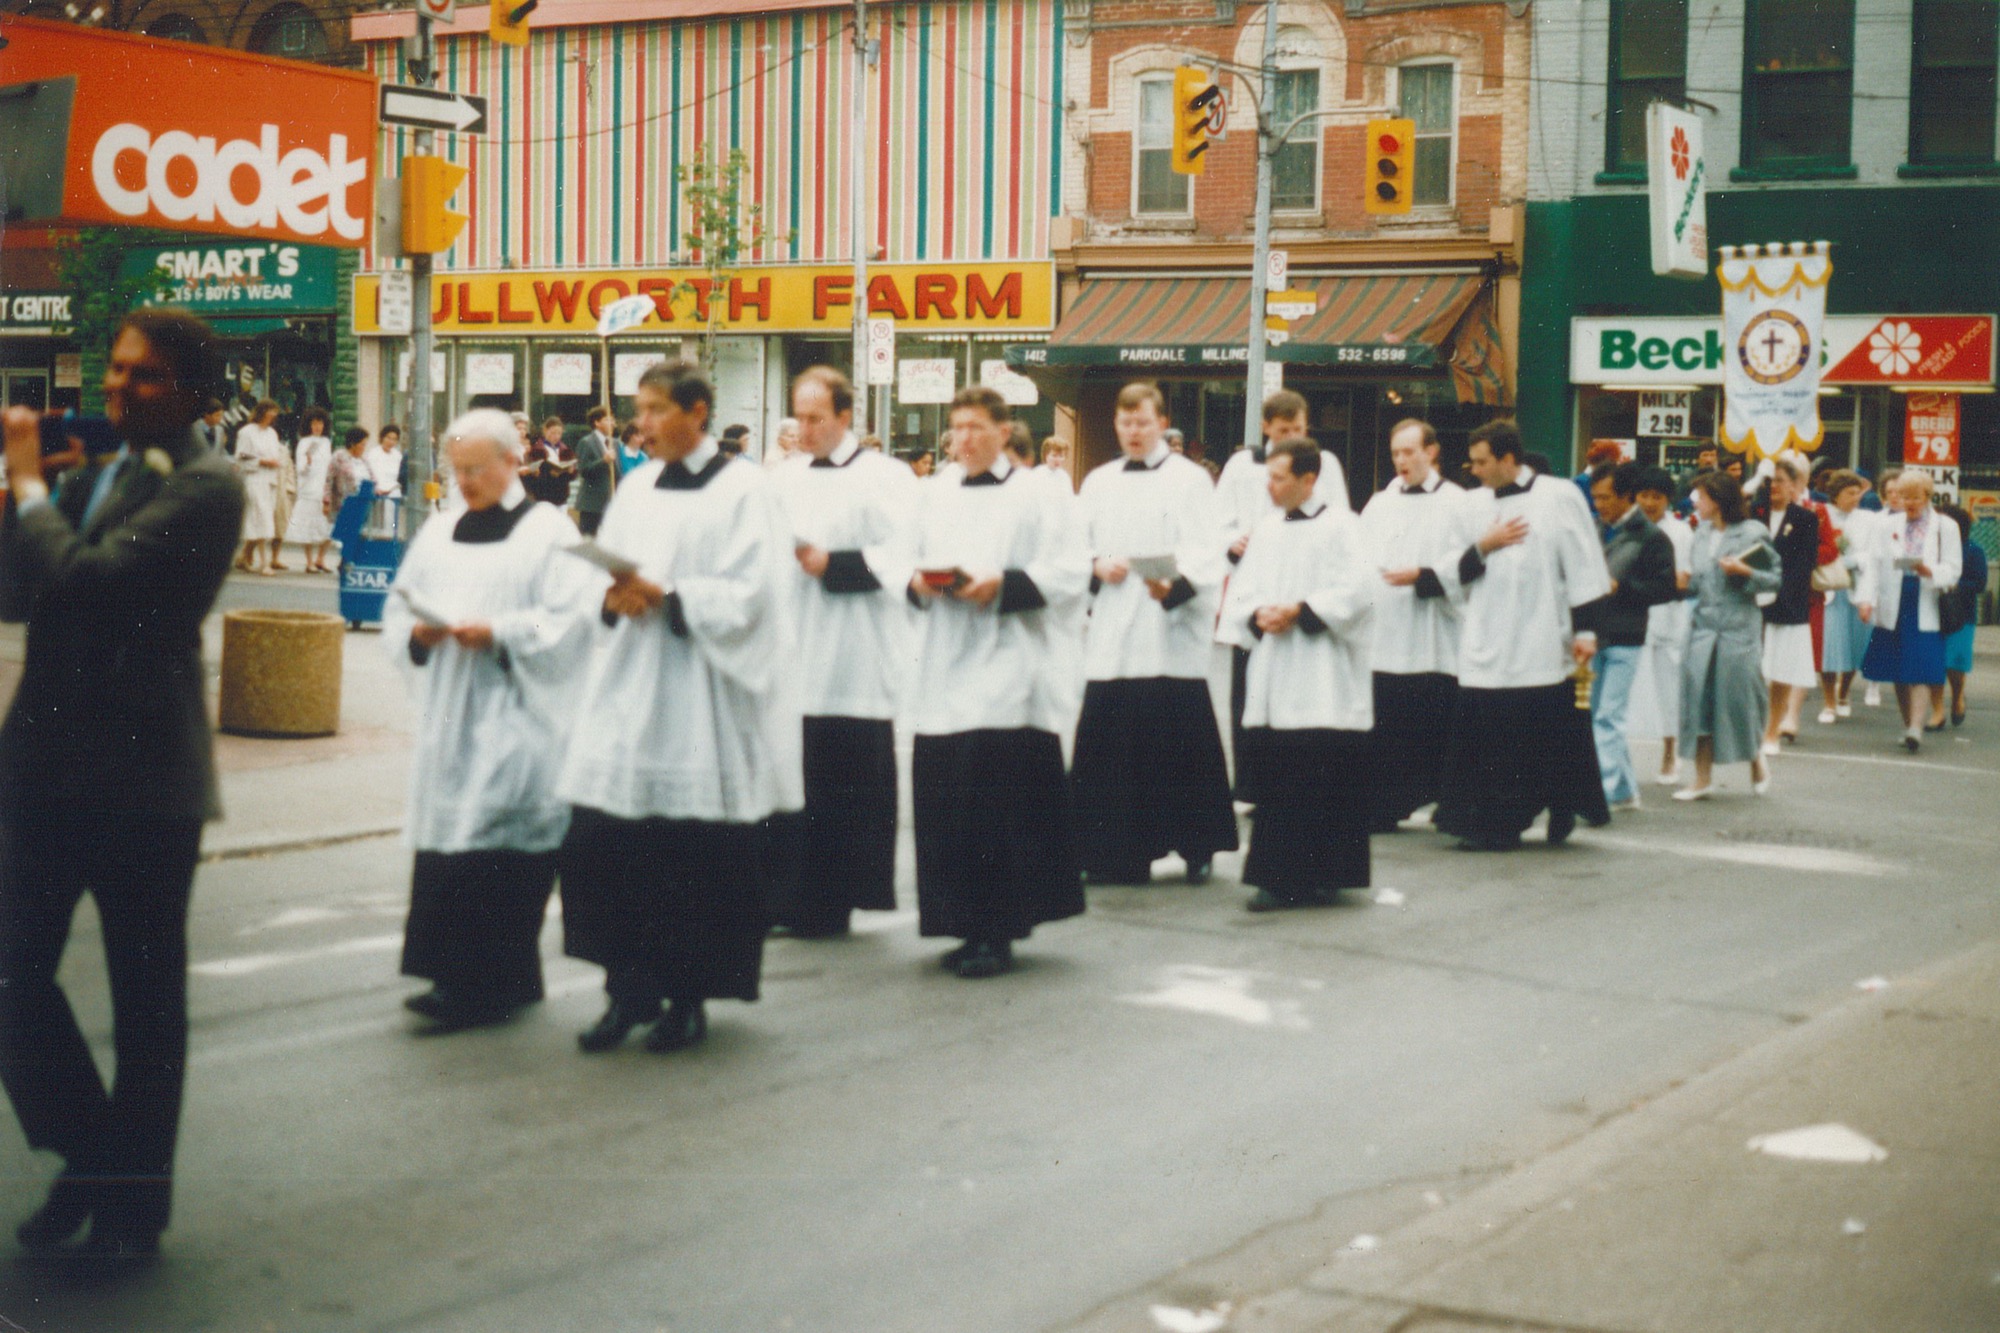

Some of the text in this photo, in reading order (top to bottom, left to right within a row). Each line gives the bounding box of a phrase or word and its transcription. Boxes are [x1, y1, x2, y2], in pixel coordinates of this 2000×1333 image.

[92, 123, 367, 240] cadet
[156, 243, 299, 280] SMART'S
[247, 282, 294, 300] WEAR
[375, 277, 771, 324] ULLWORTH
[814, 272, 1023, 320] FARM
[1958, 320, 1988, 348] FOODS
[1025, 348, 1047, 361] 1412
[1120, 348, 1185, 361] PARKDALE
[1202, 348, 1249, 361] MILLINE
[1917, 347, 1944, 375] FRESH
[1931, 346, 1957, 375] READY
[1642, 391, 1687, 408] MILK
[1650, 414, 1683, 434] 2.99
[346, 571, 389, 589] STAR
